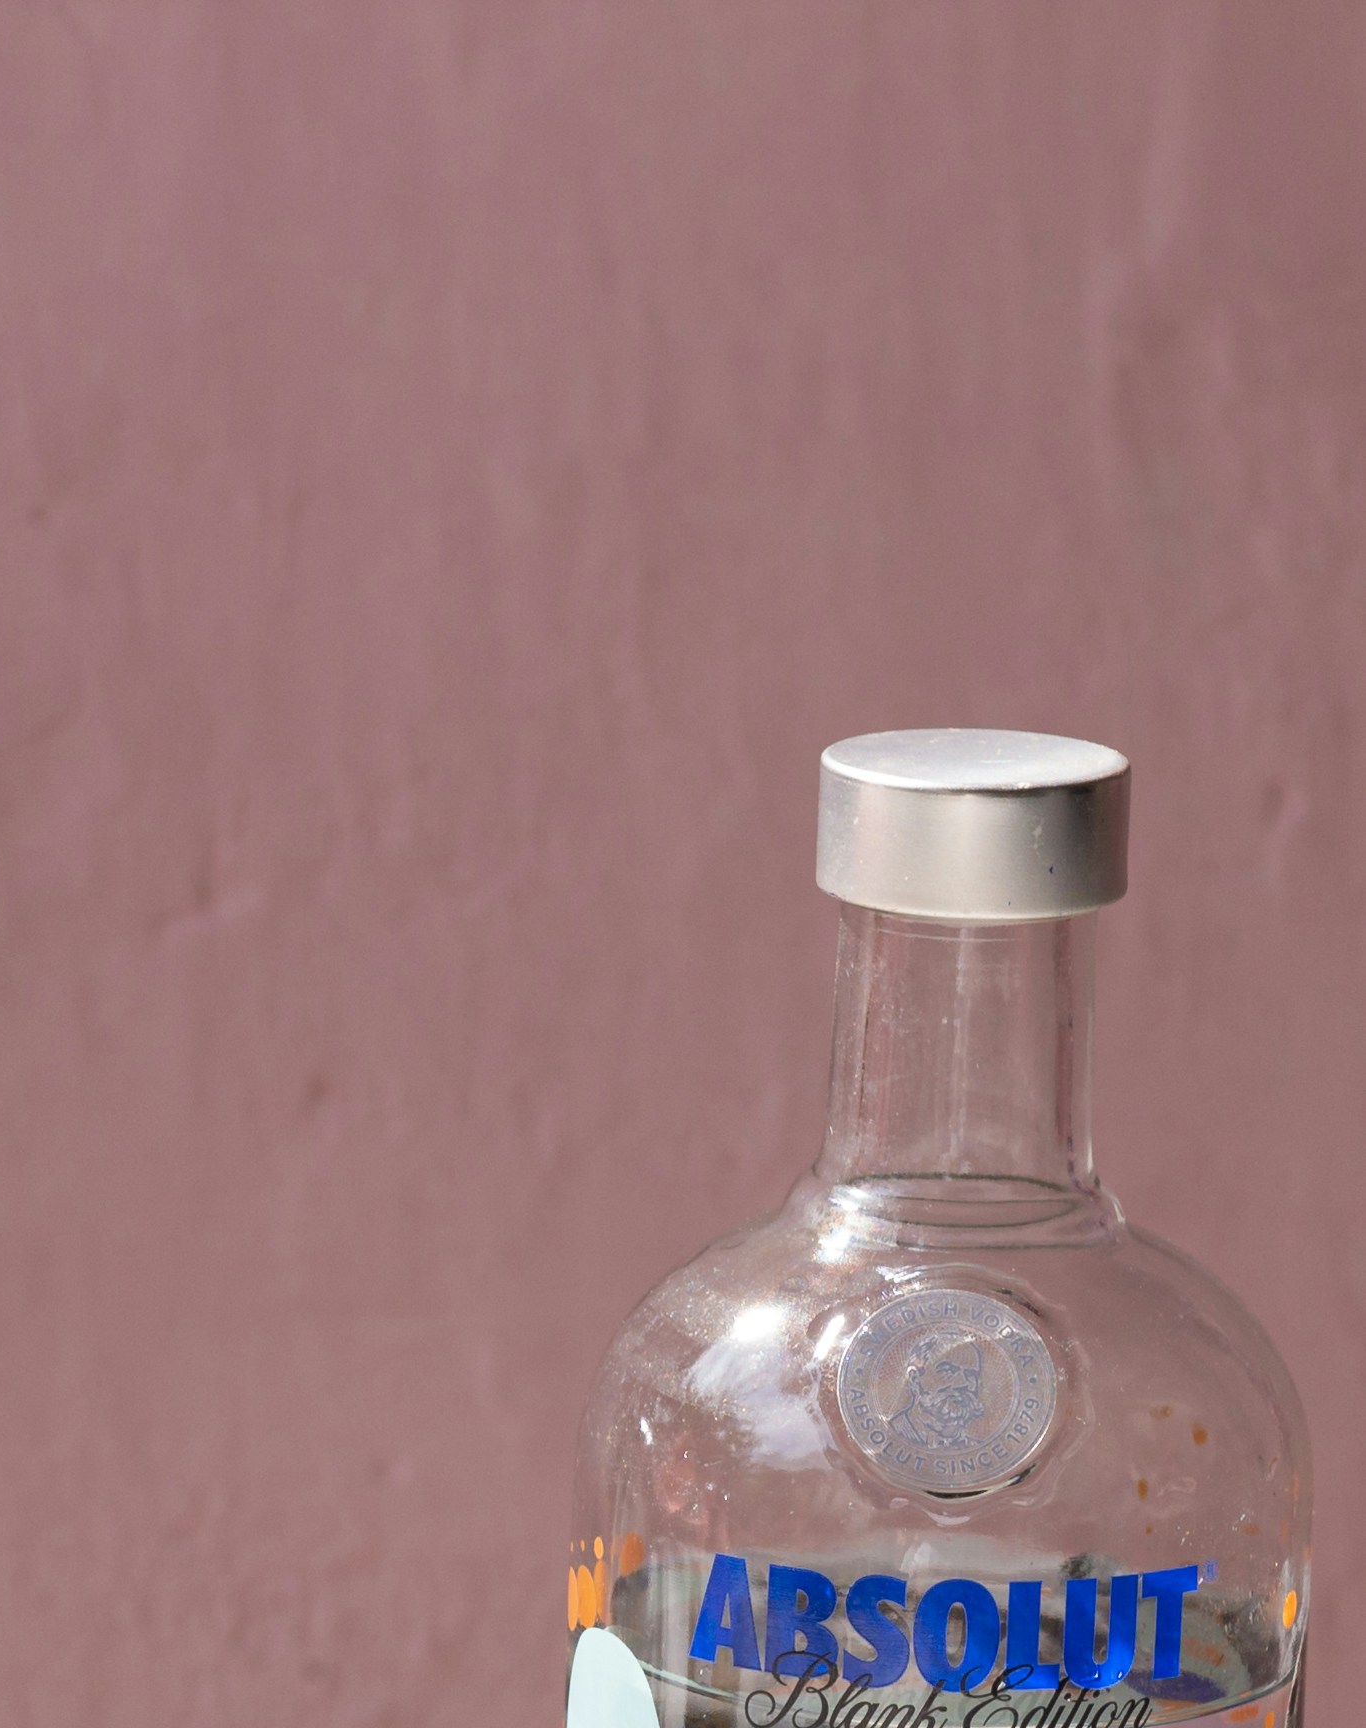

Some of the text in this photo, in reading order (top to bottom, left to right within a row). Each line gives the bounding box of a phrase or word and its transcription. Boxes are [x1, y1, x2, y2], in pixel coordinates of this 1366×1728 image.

[861, 1303, 1034, 1367] SWEDISH VODKA
[851, 1388, 1040, 1474] ABSOLUT SINCE 1879
[688, 1553, 1199, 1693] ABSOLUT
